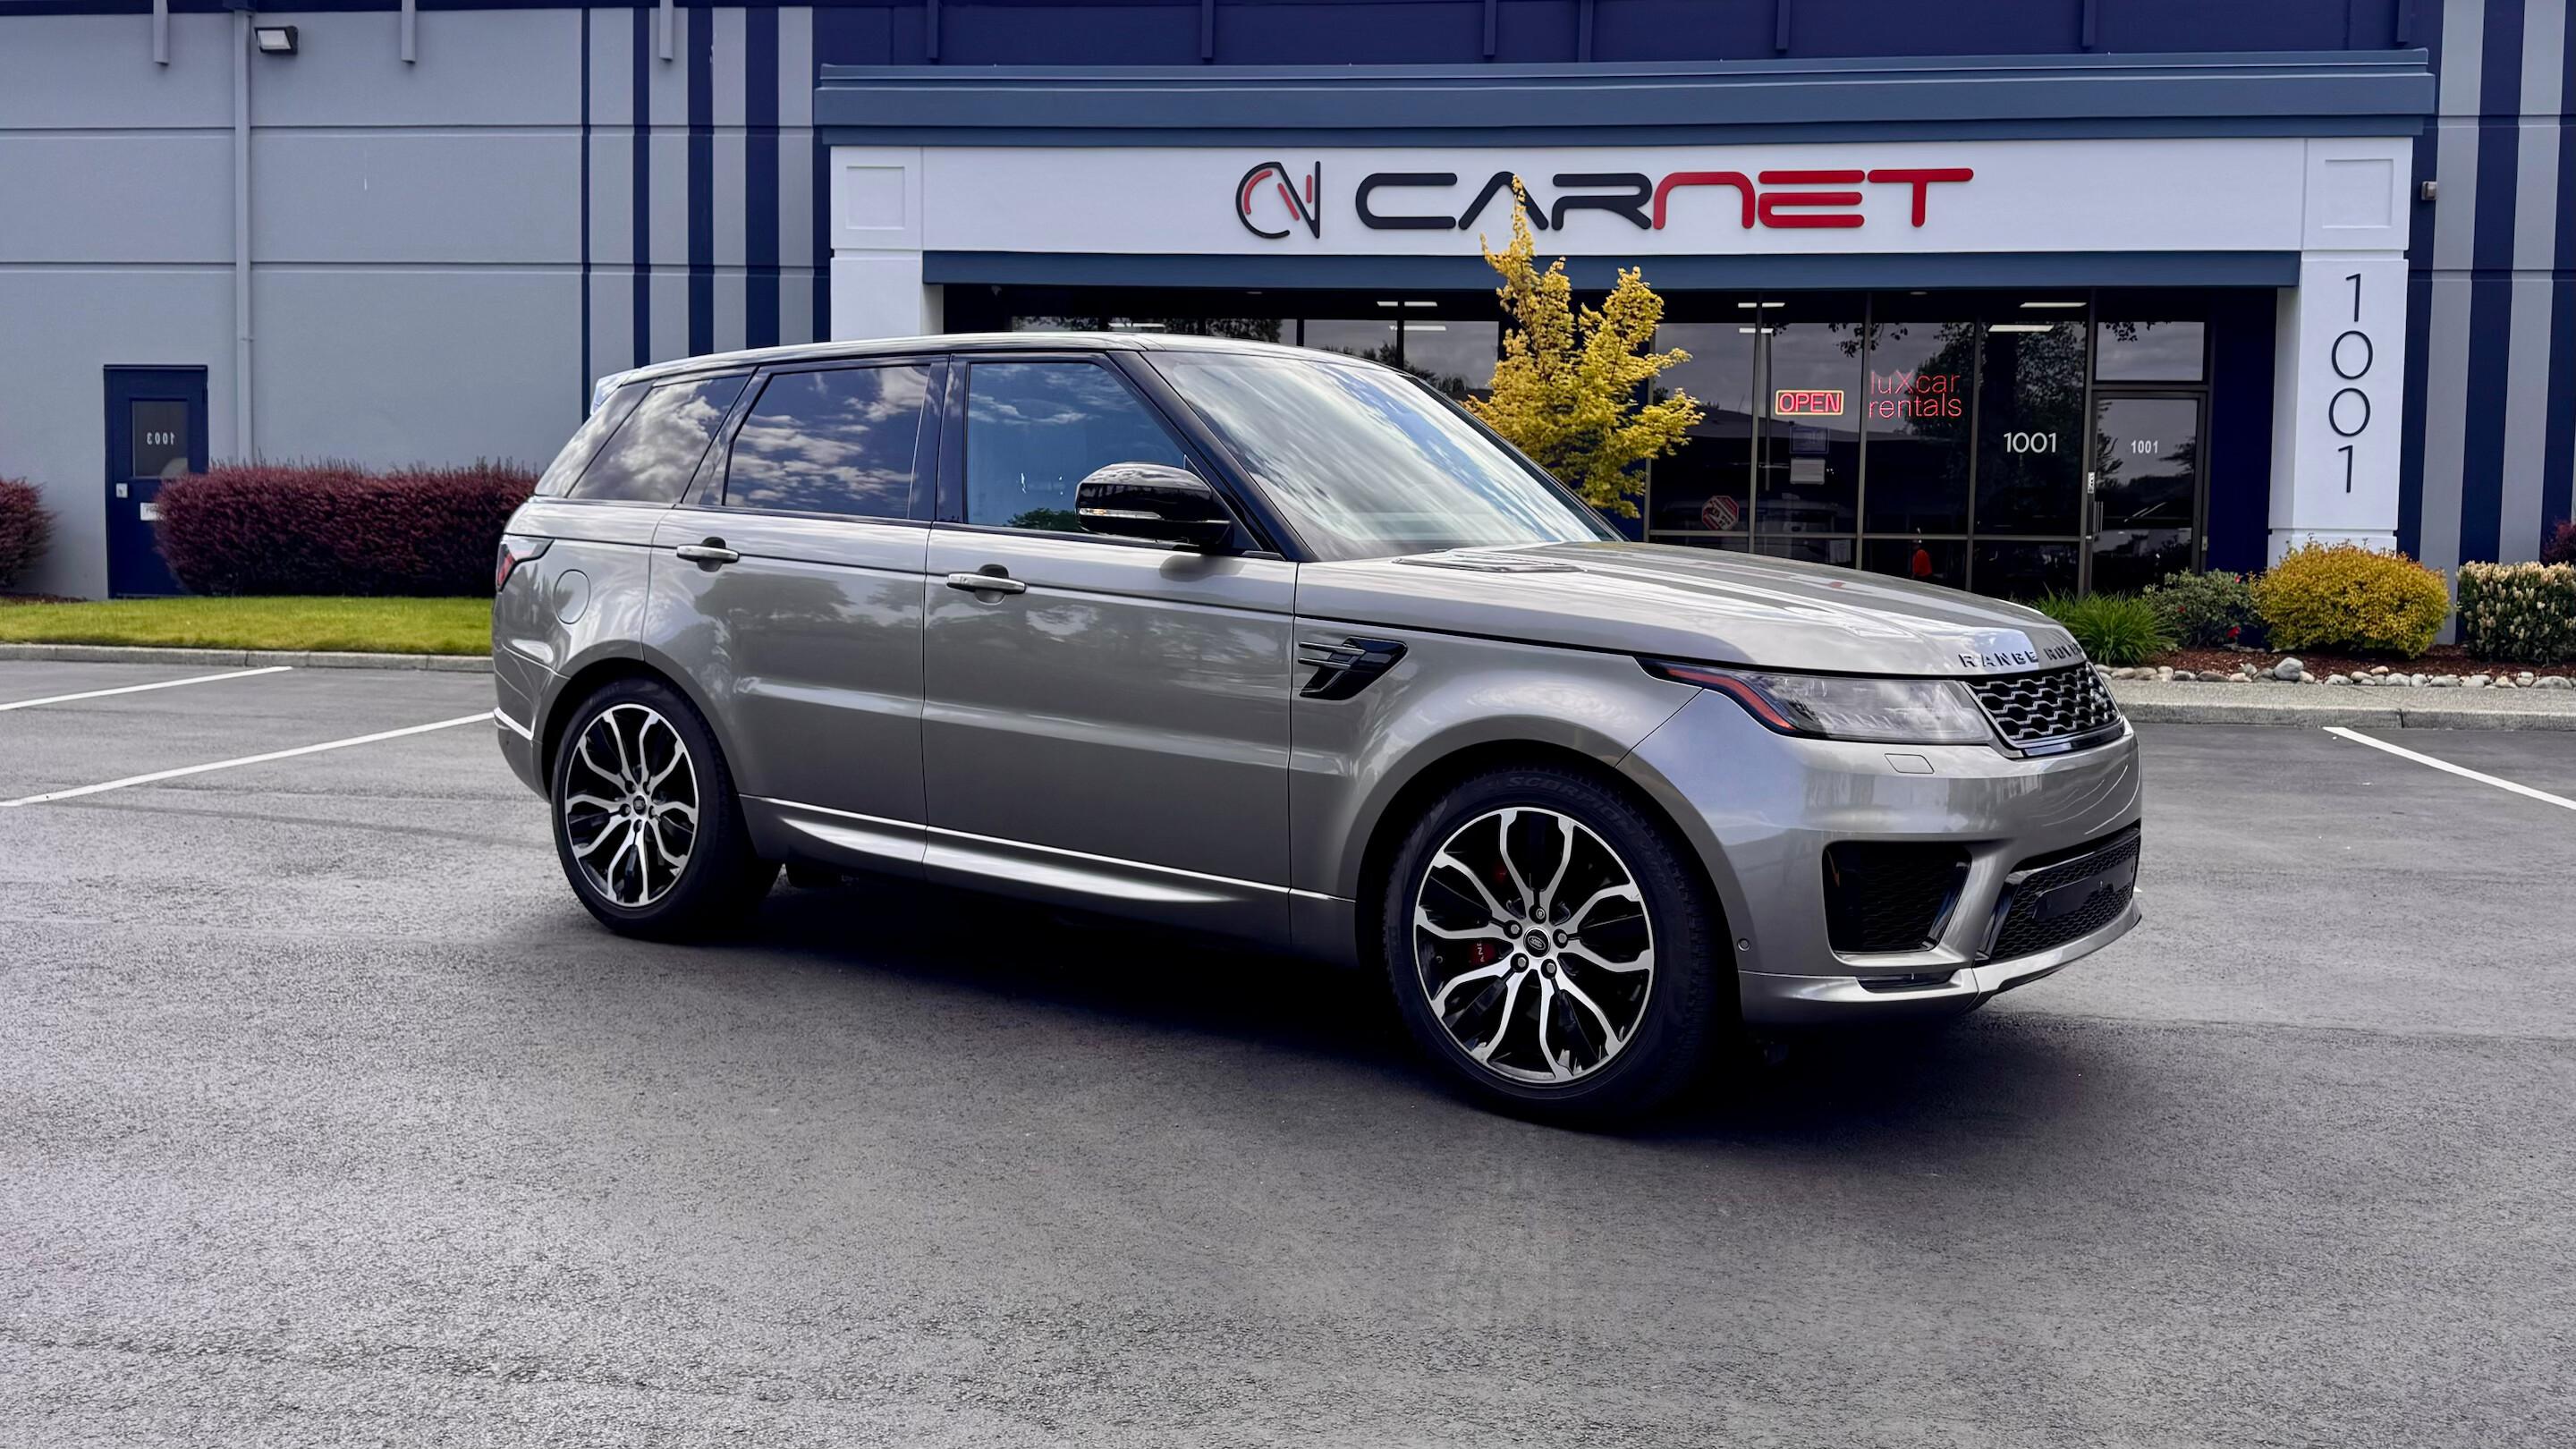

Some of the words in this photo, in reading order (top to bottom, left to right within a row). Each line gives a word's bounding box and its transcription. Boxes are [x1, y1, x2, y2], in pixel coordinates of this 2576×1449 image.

[1355, 167, 1974, 231] CARNET
[2328, 273, 2374, 494] 1001
[1779, 393, 1841, 413] OPEN
[1868, 394, 1962, 419] rentals
[2003, 432, 2056, 453] 1001
[2131, 440, 2158, 454] 1001
[1958, 650, 2039, 667] RANGE
